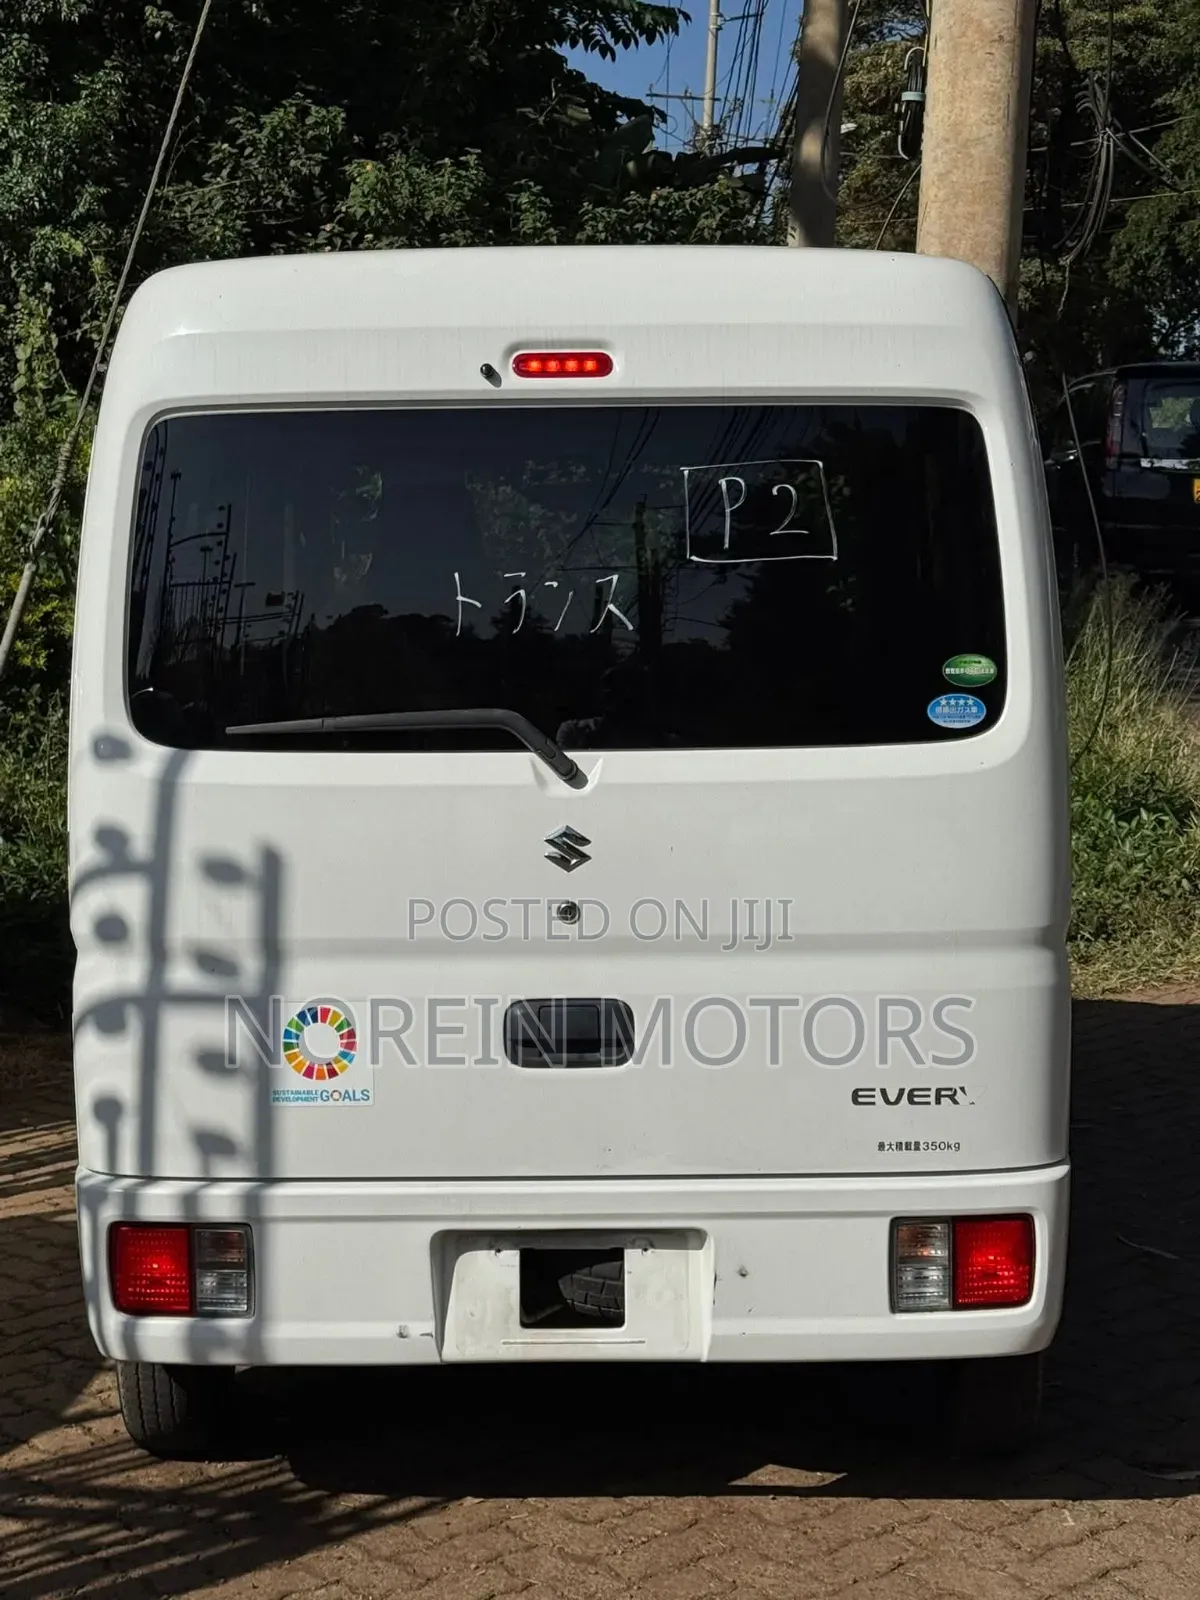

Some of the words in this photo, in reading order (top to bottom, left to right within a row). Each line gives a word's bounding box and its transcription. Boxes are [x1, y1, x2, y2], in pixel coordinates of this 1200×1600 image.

[454, 572, 635, 636] トランス
[320, 1089, 370, 1102] GOALS
[851, 1086, 975, 1106] EVER
